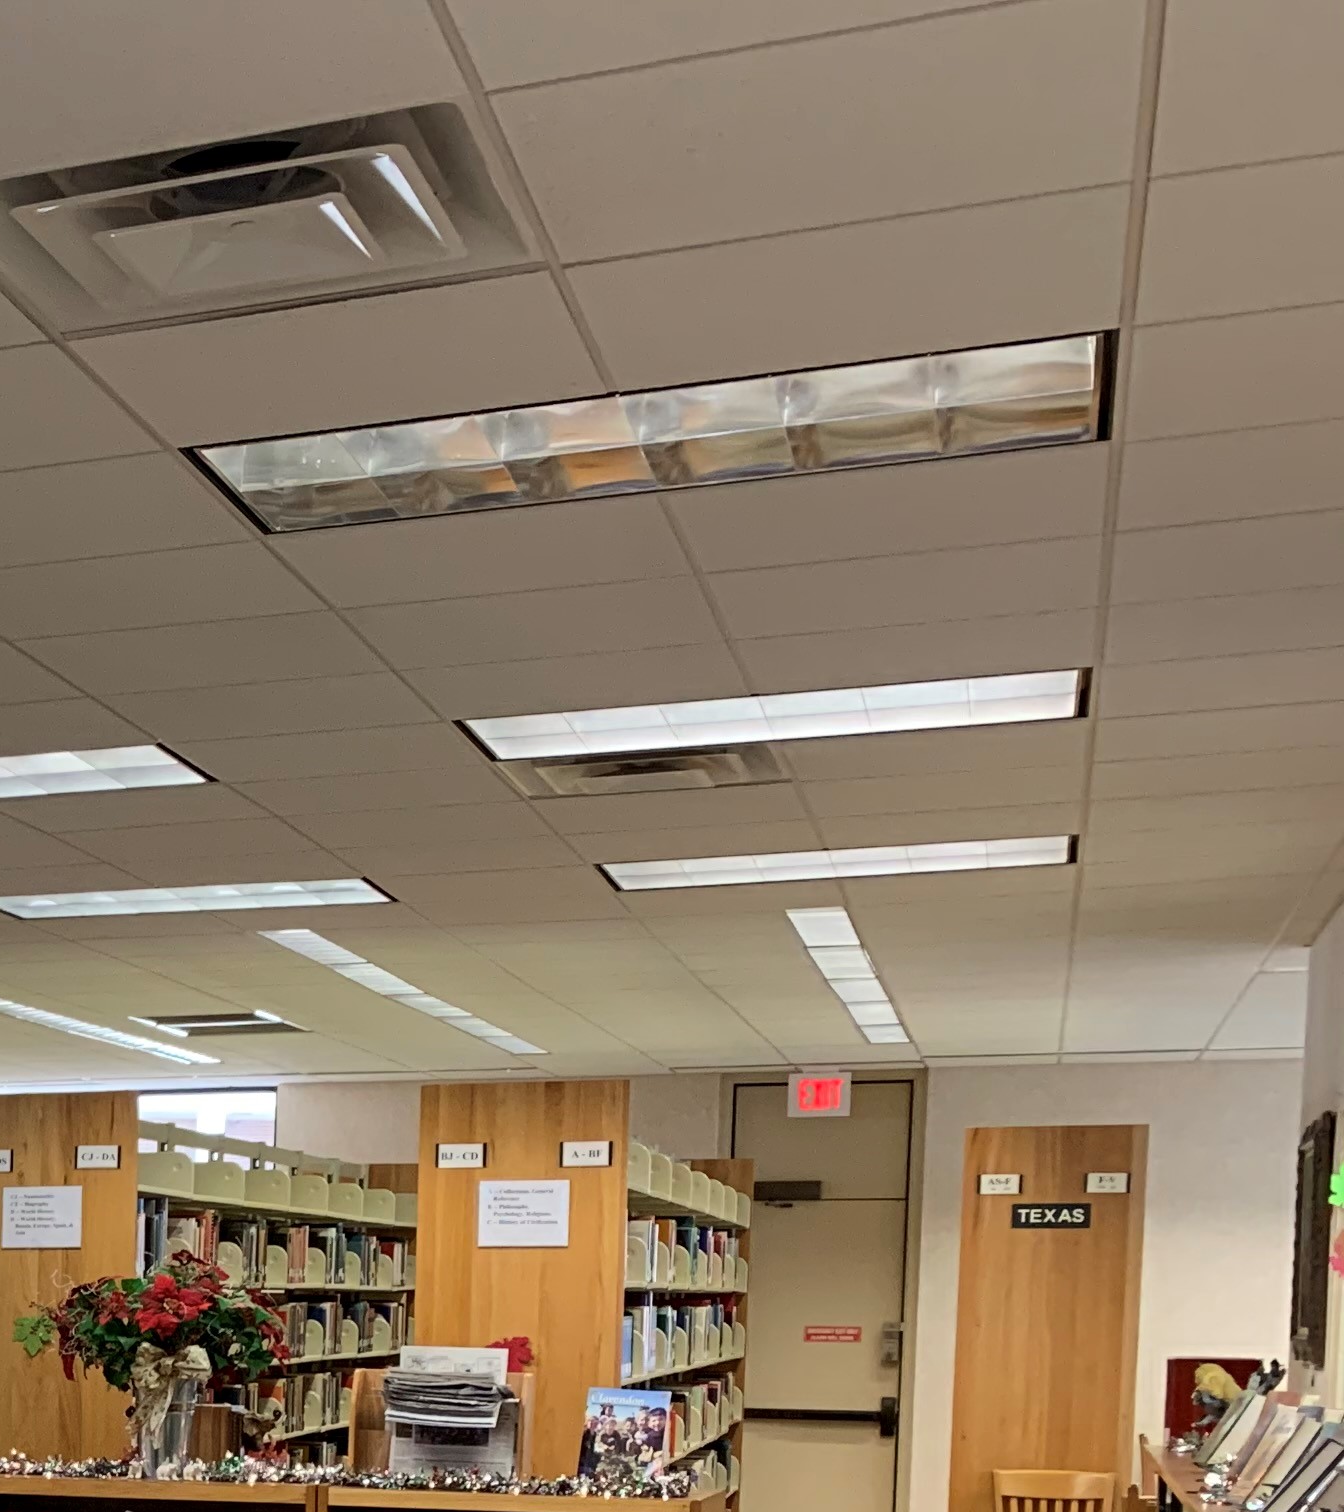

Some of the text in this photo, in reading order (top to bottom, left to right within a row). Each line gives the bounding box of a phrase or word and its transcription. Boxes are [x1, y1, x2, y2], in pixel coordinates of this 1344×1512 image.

[797, 1078, 843, 1111] EXIT
[81, 1152, 94, 1161] CJ
[102, 1152, 116, 1161] DA
[441, 1152, 454, 1161] BJ
[462, 1151, 479, 1161] CD
[571, 1151, 579, 1159] A
[1018, 1208, 1085, 1223] TEXAS
